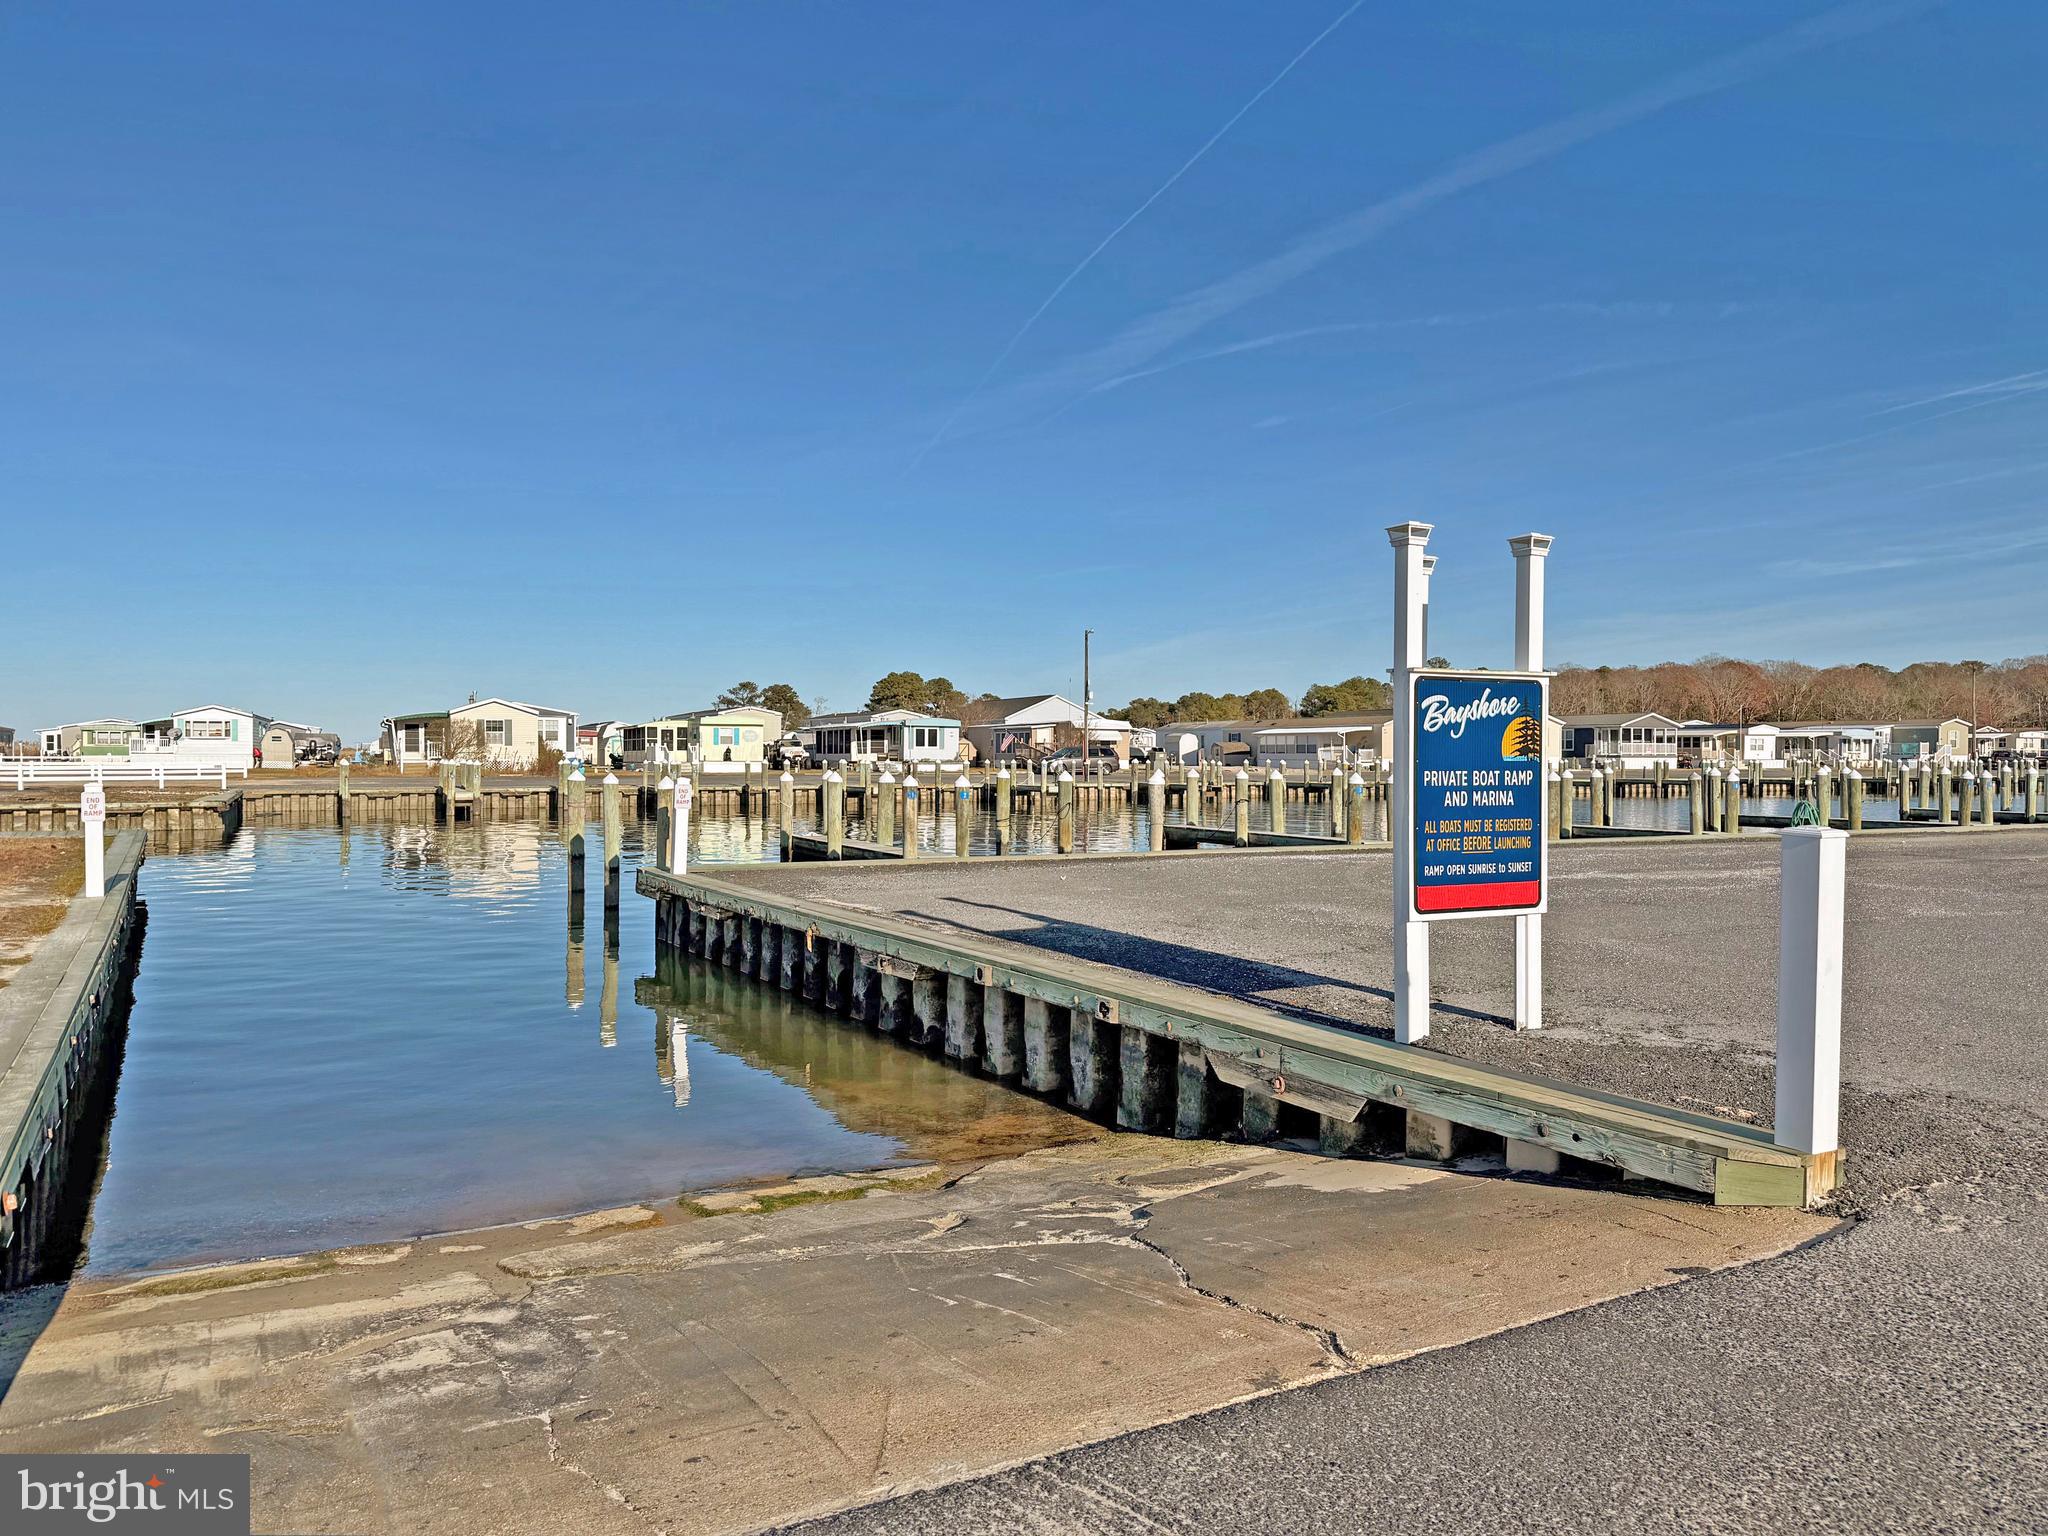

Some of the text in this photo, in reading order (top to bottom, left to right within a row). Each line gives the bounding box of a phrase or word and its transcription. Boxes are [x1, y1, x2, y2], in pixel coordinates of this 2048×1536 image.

[1421, 688, 1521, 738] Bayshore
[1424, 770, 1533, 786] PRIVATE BOAT RAMP
[1444, 790, 1514, 807] AND MARINA
[1425, 818, 1533, 833] ALL BOATS MUST BE REGISTERED
[1426, 836, 1531, 851] AT OFFICE BEFORE LAUNCHING
[1425, 862, 1532, 876] RAMP OPEN SUNRISE to SUNSET
